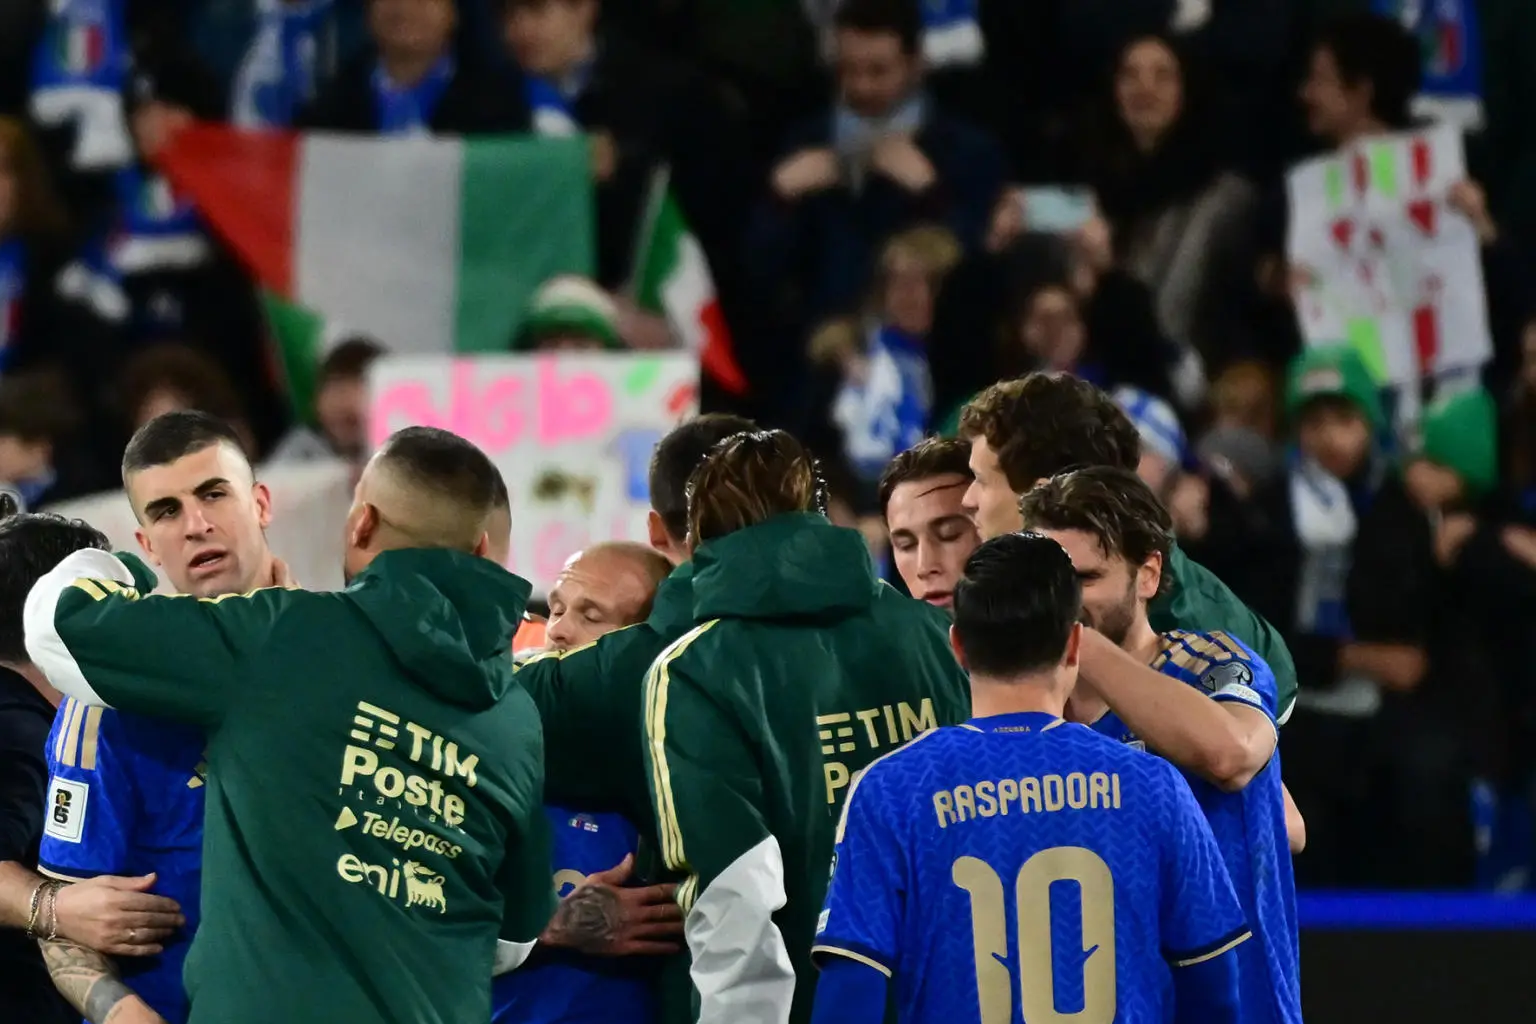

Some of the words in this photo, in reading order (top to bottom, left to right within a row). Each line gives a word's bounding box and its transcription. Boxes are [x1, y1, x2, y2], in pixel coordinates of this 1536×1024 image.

[856, 698, 937, 748] TIM
[406, 722, 479, 787] TIM
[340, 745, 465, 825] Poste
[933, 772, 1121, 829] RASPADORI
[363, 811, 462, 858] Telepass
[337, 854, 401, 898] eni
